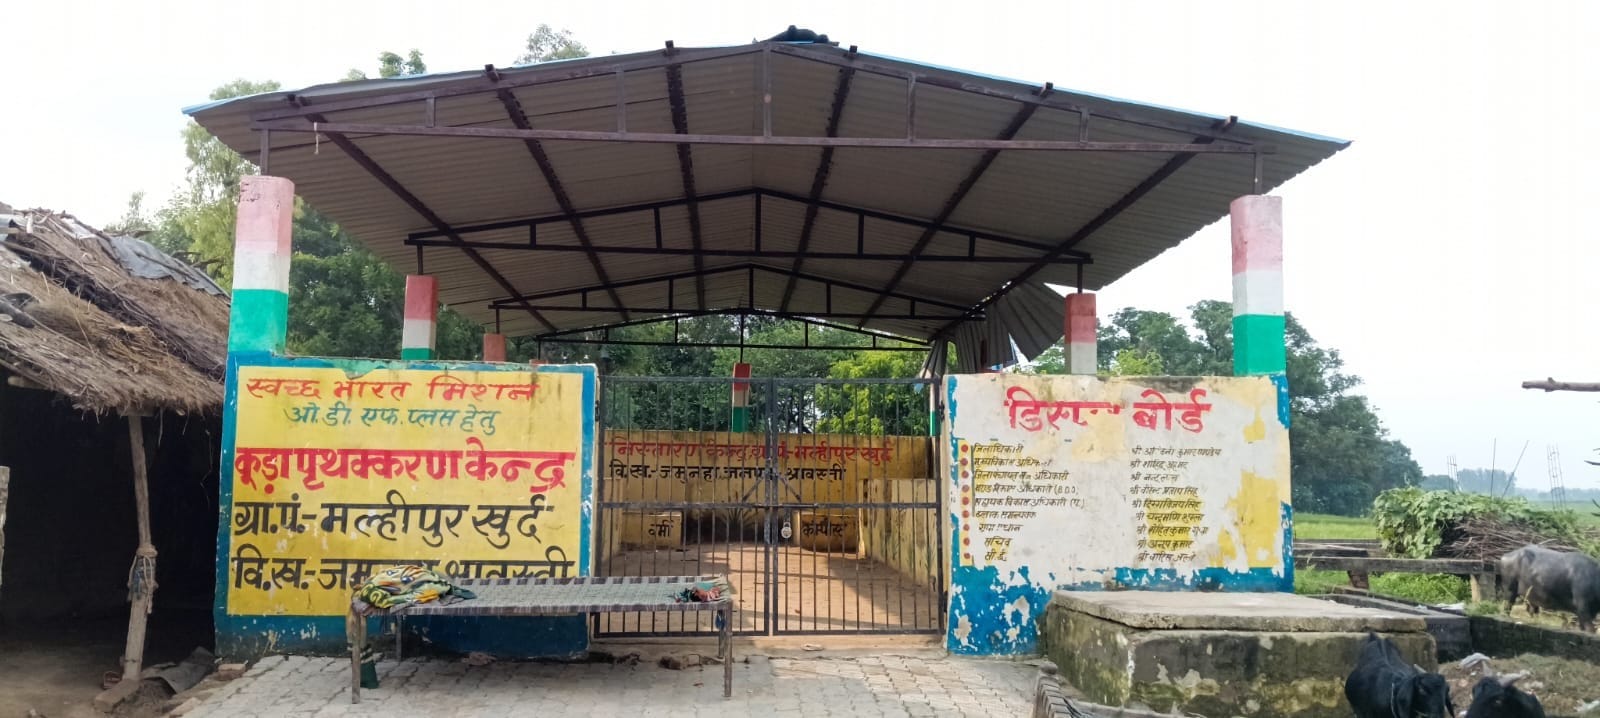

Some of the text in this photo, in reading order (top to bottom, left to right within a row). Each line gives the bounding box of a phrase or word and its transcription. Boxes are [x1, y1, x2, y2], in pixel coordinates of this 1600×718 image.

[246, 375, 540, 401] स्वच्छ भारत मिशन
[1132, 388, 1212, 433] बोर्ड
[459, 404, 501, 435] हेतु
[294, 448, 464, 492] पृथक्करण
[463, 437, 576, 492] केन्द्र
[321, 490, 470, 548] मल्हीपुर
[471, 494, 554, 549] खुर्द
